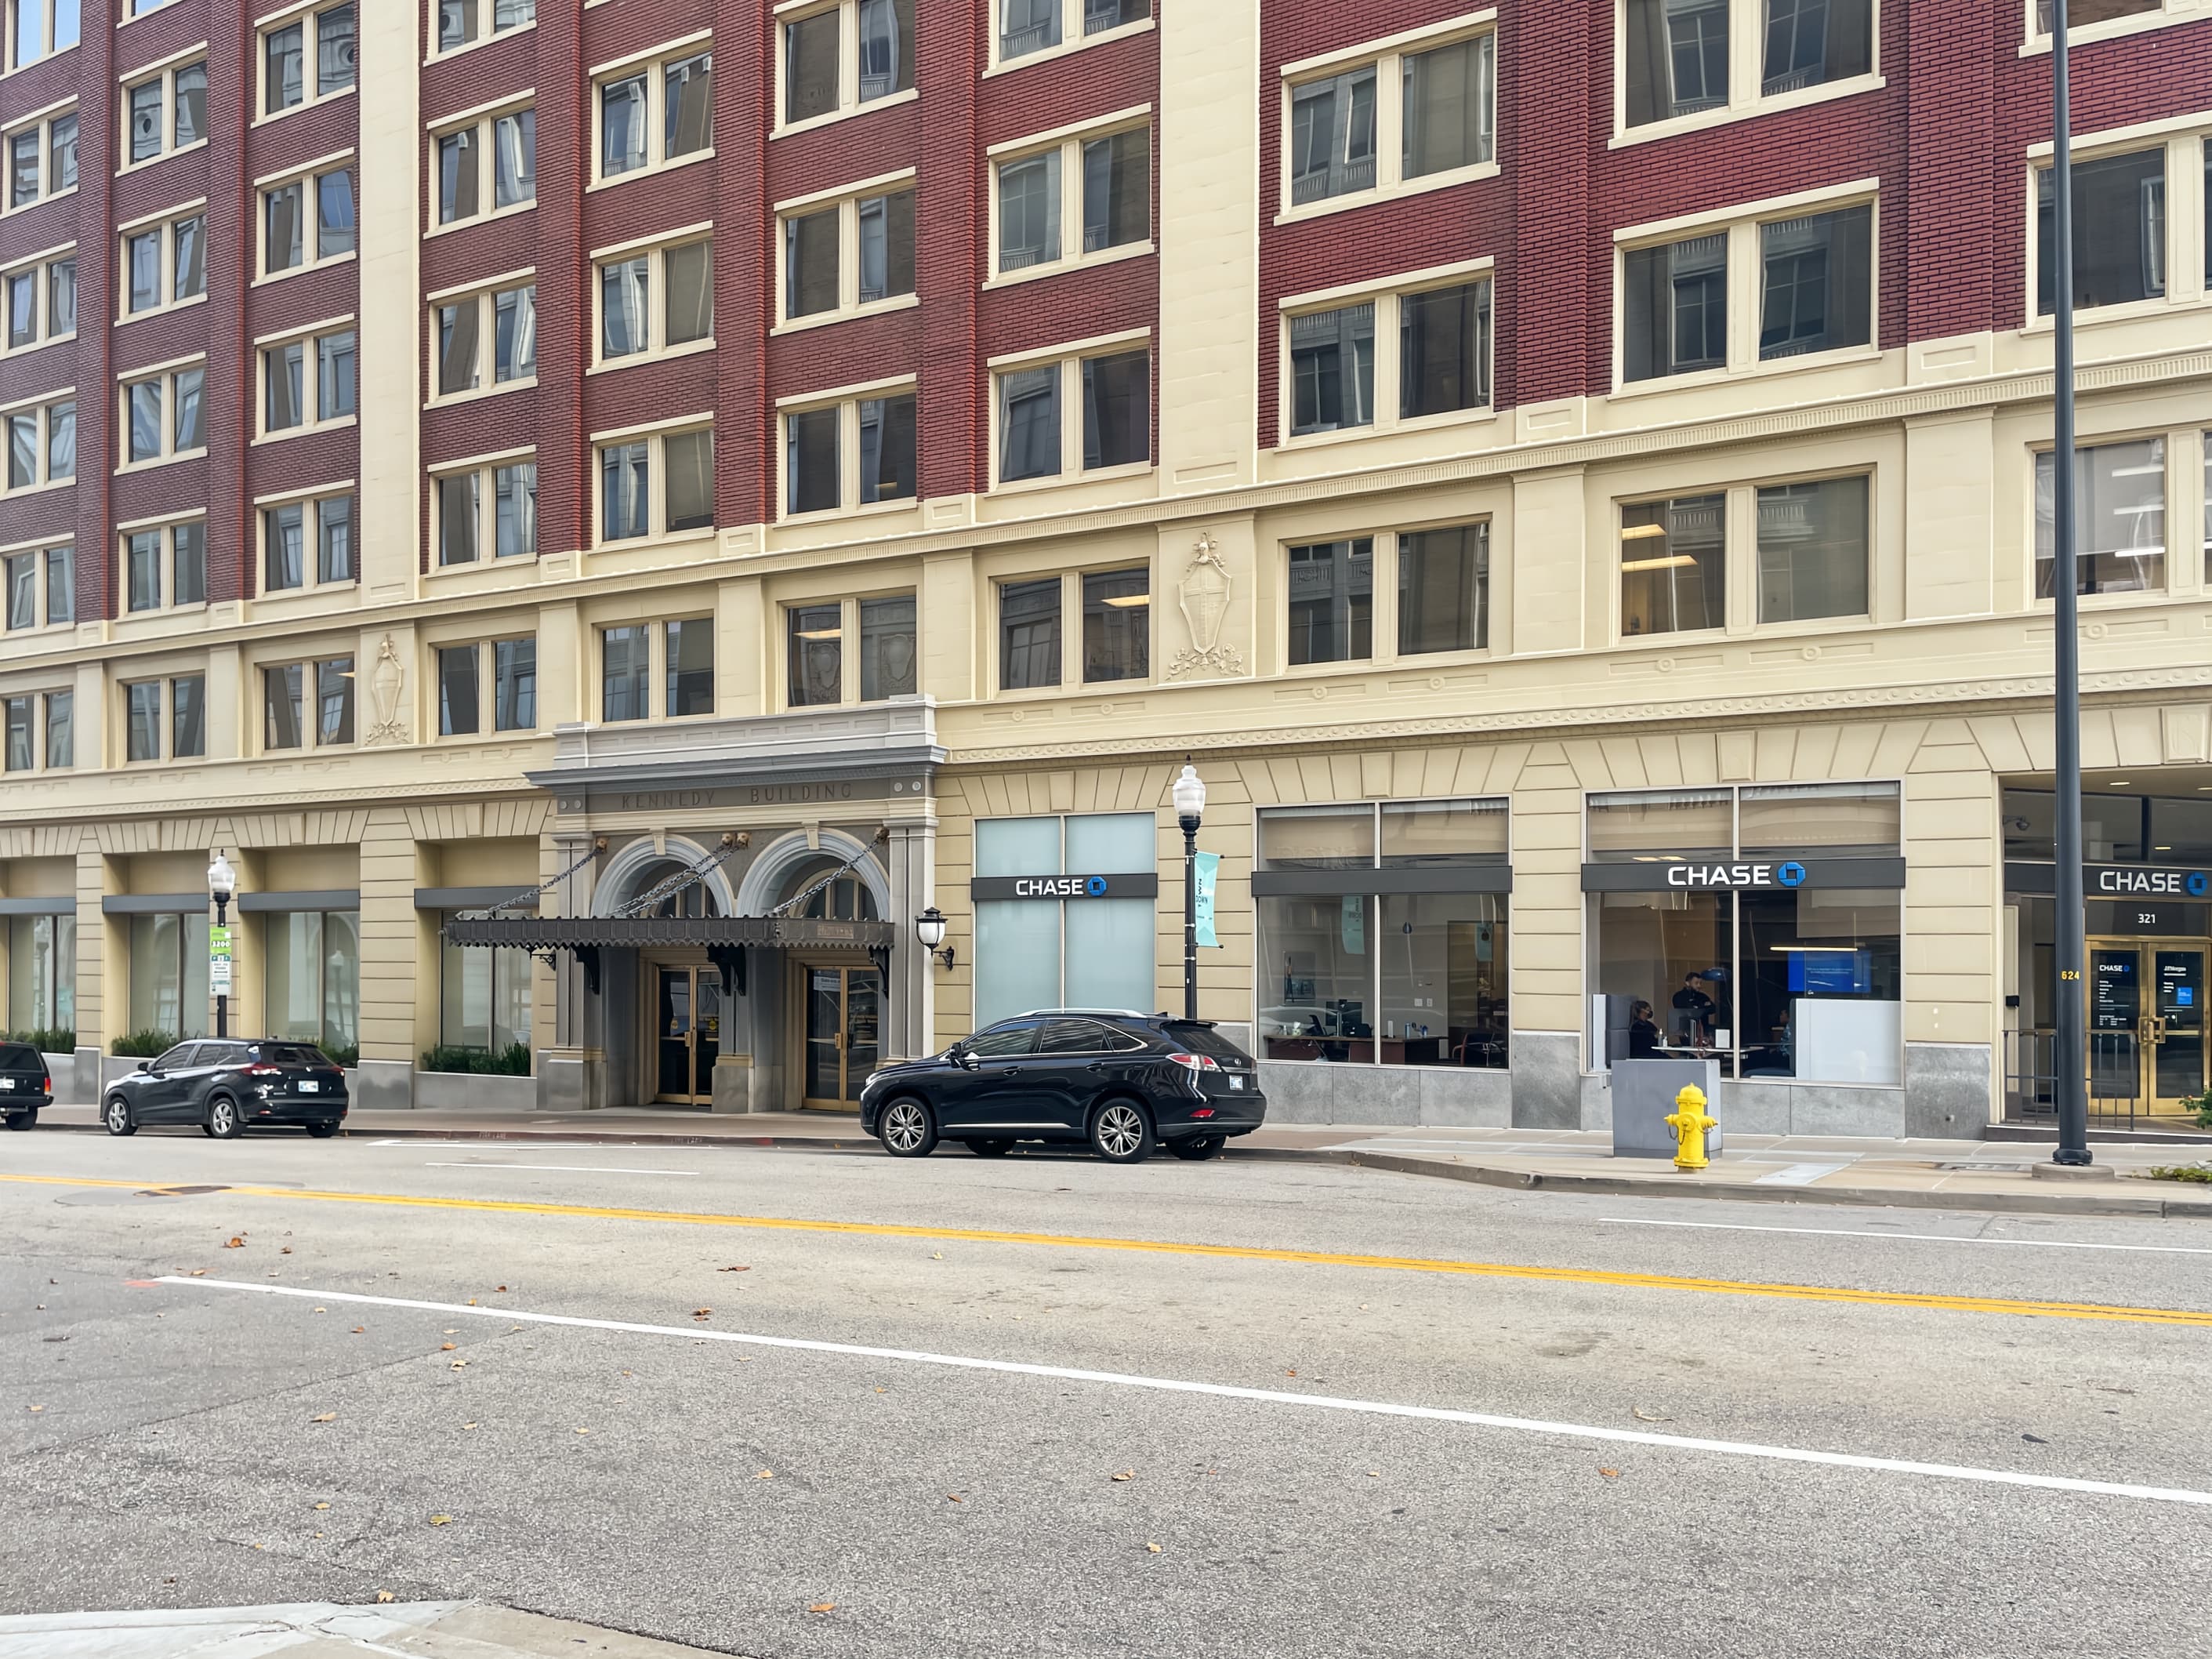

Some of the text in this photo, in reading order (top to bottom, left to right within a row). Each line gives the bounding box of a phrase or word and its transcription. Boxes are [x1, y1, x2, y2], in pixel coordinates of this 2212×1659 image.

[622, 783, 852, 809] KENNEDY BUILDING
[1667, 865, 1771, 886] CHASE
[2100, 871, 2181, 893] CHASE
[1016, 879, 1084, 895] CHASE
[2138, 913, 2156, 924] 321
[2061, 971, 2080, 980] 624
